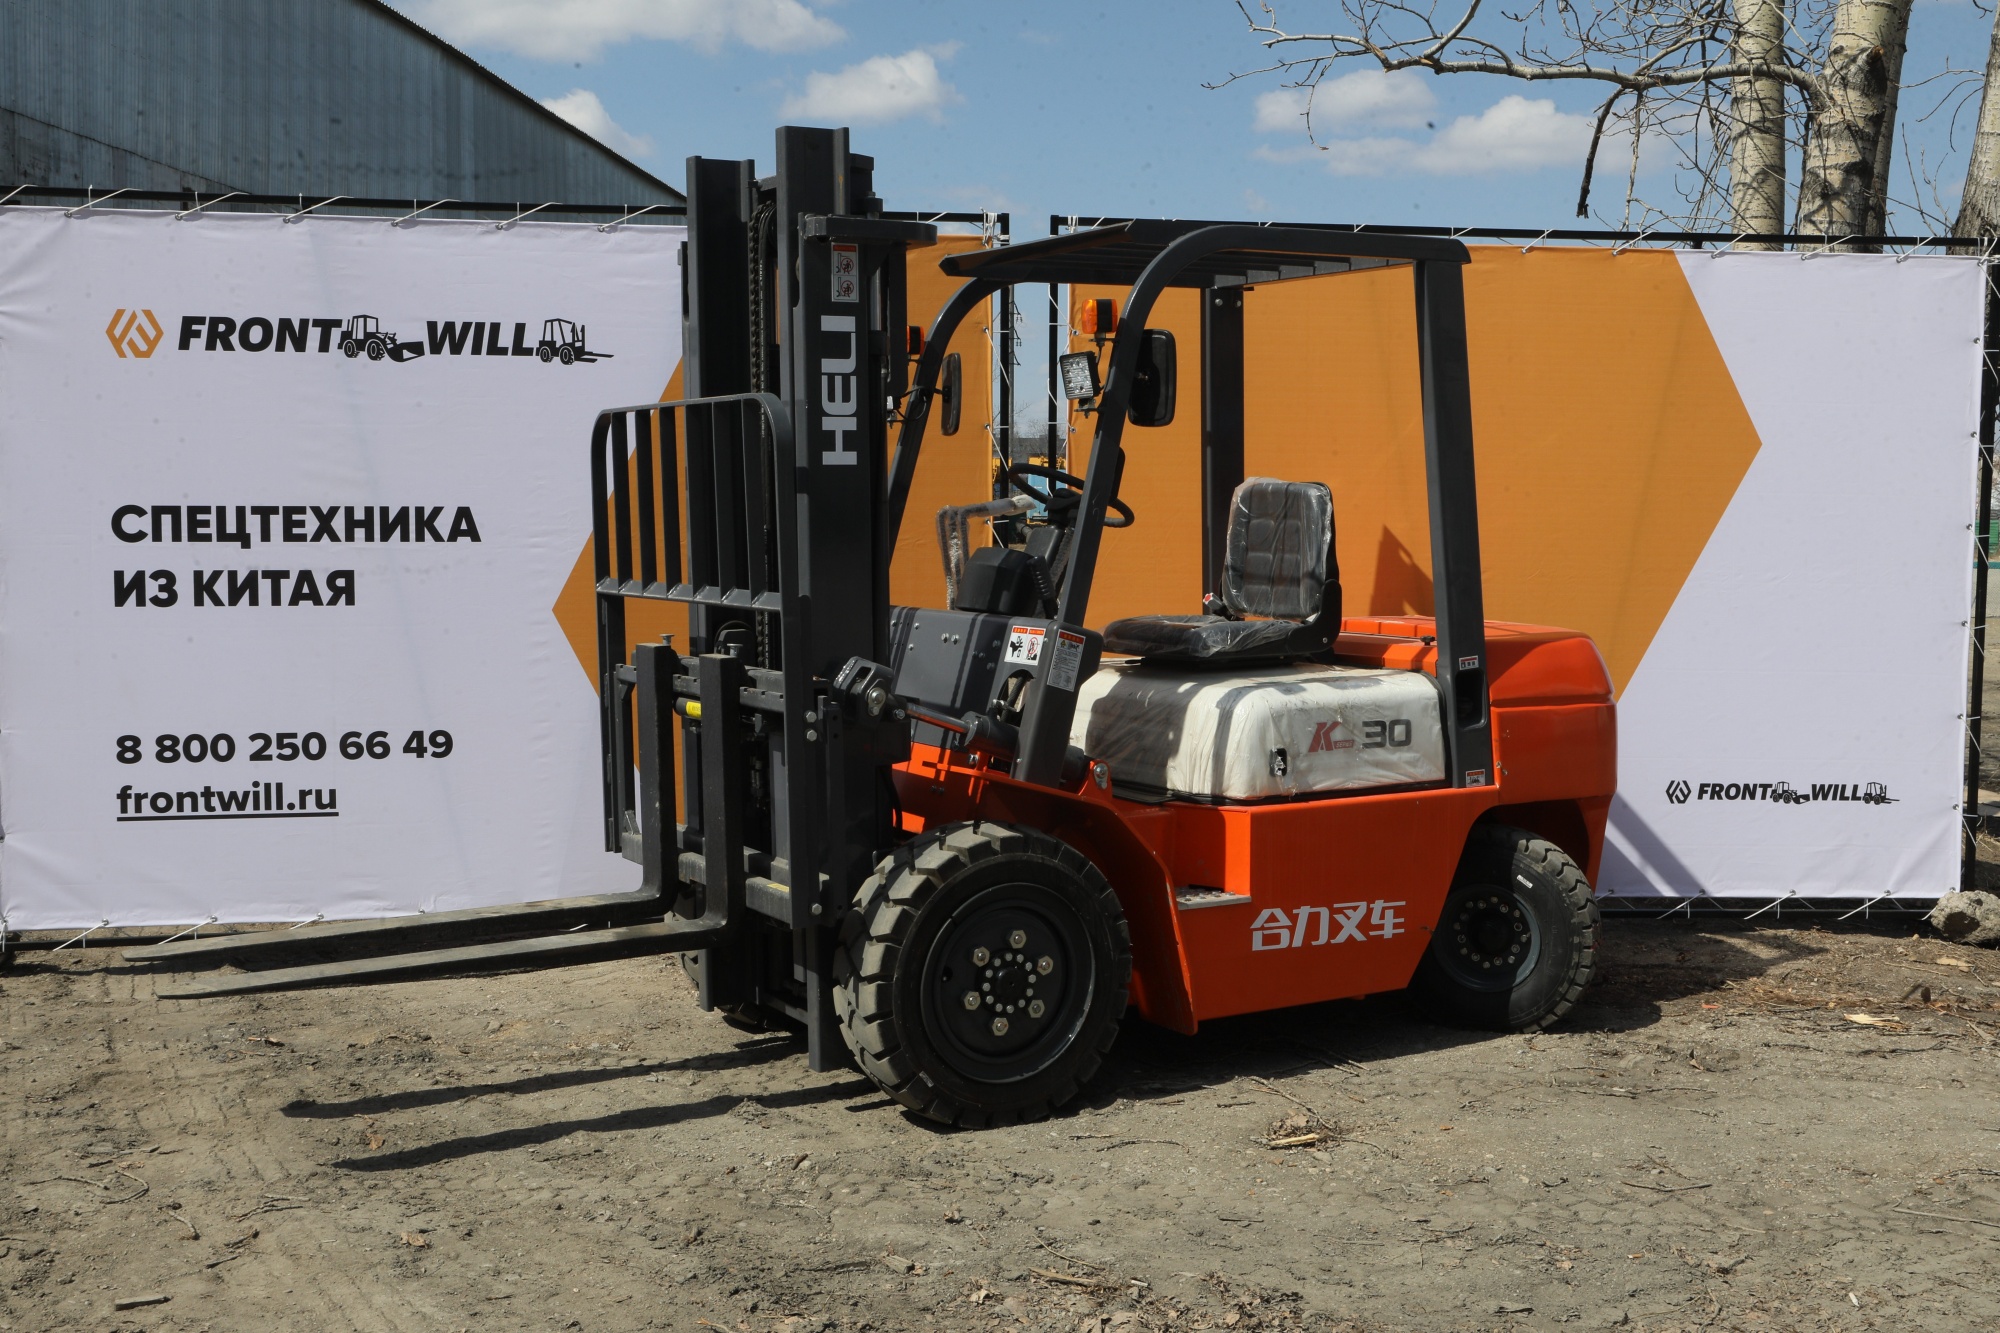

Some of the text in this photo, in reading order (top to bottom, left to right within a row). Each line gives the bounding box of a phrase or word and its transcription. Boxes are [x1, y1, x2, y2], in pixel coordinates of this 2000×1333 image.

[178, 315, 535, 357] FRONT WILL
[821, 315, 858, 466] HELI
[110, 504, 482, 550] СПЕЦТЕХНИКА
[113, 569, 356, 608] ИЗ КИТАЯ
[116, 729, 454, 765] 8 800 250 66 49
[1308, 721, 1341, 753] K
[1362, 718, 1412, 750] 30
[116, 782, 338, 815] frontwill.ru
[1697, 783, 1863, 801] FRONT WILL
[1251, 900, 1406, 951] 合力叉车
